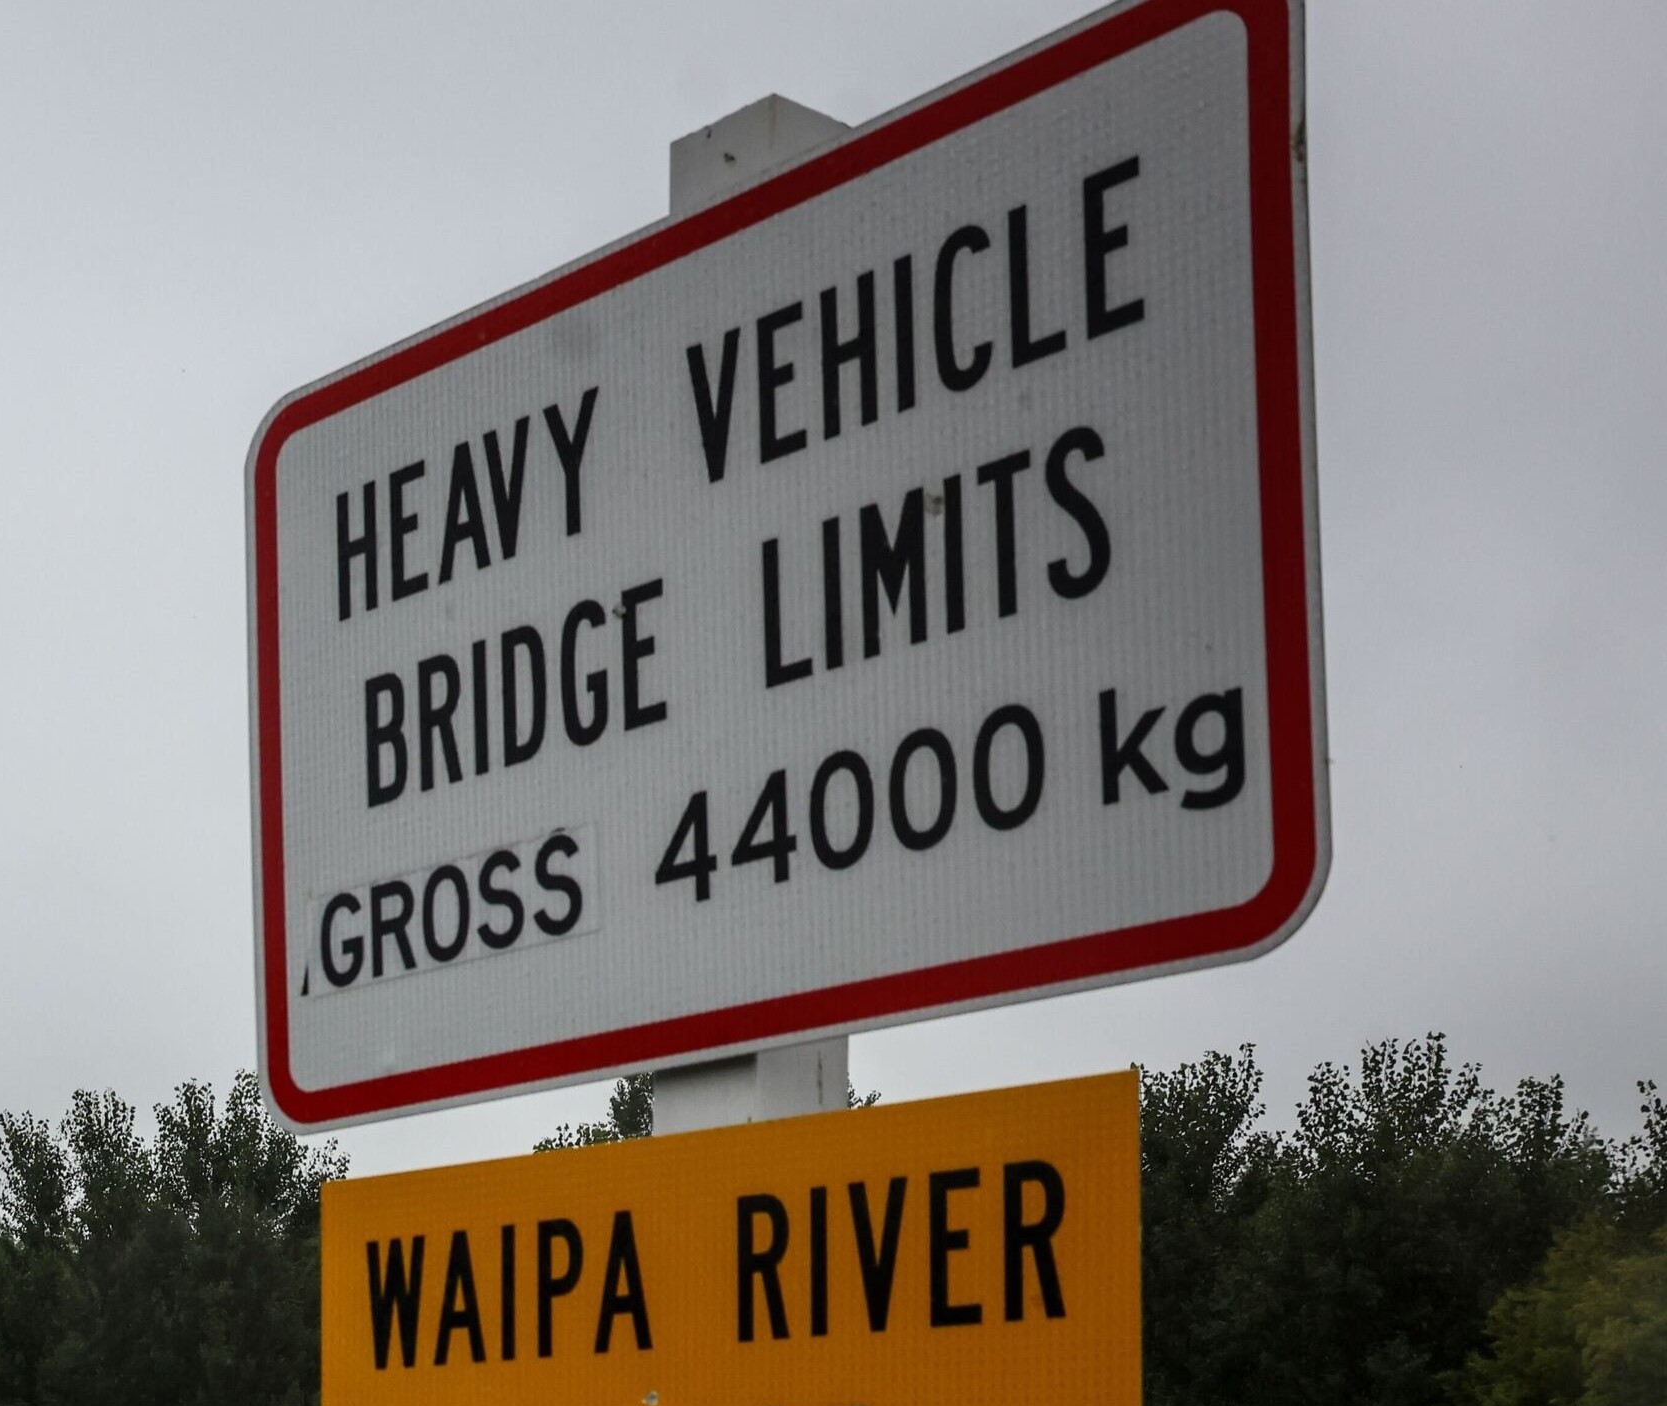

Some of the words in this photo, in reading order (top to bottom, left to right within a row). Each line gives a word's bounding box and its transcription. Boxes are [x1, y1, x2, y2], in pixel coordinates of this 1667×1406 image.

[337, 387, 598, 621] HEAVY
[686, 155, 1145, 483] VEHICLE
[365, 579, 667, 807] BRIDGE
[762, 426, 1111, 688] LIMITS
[321, 835, 582, 987] GROSS
[655, 704, 1045, 902] 44000
[1099, 687, 1245, 811] kg
[367, 1211, 652, 1369] WAIPA
[738, 1160, 1065, 1342] RIVER
